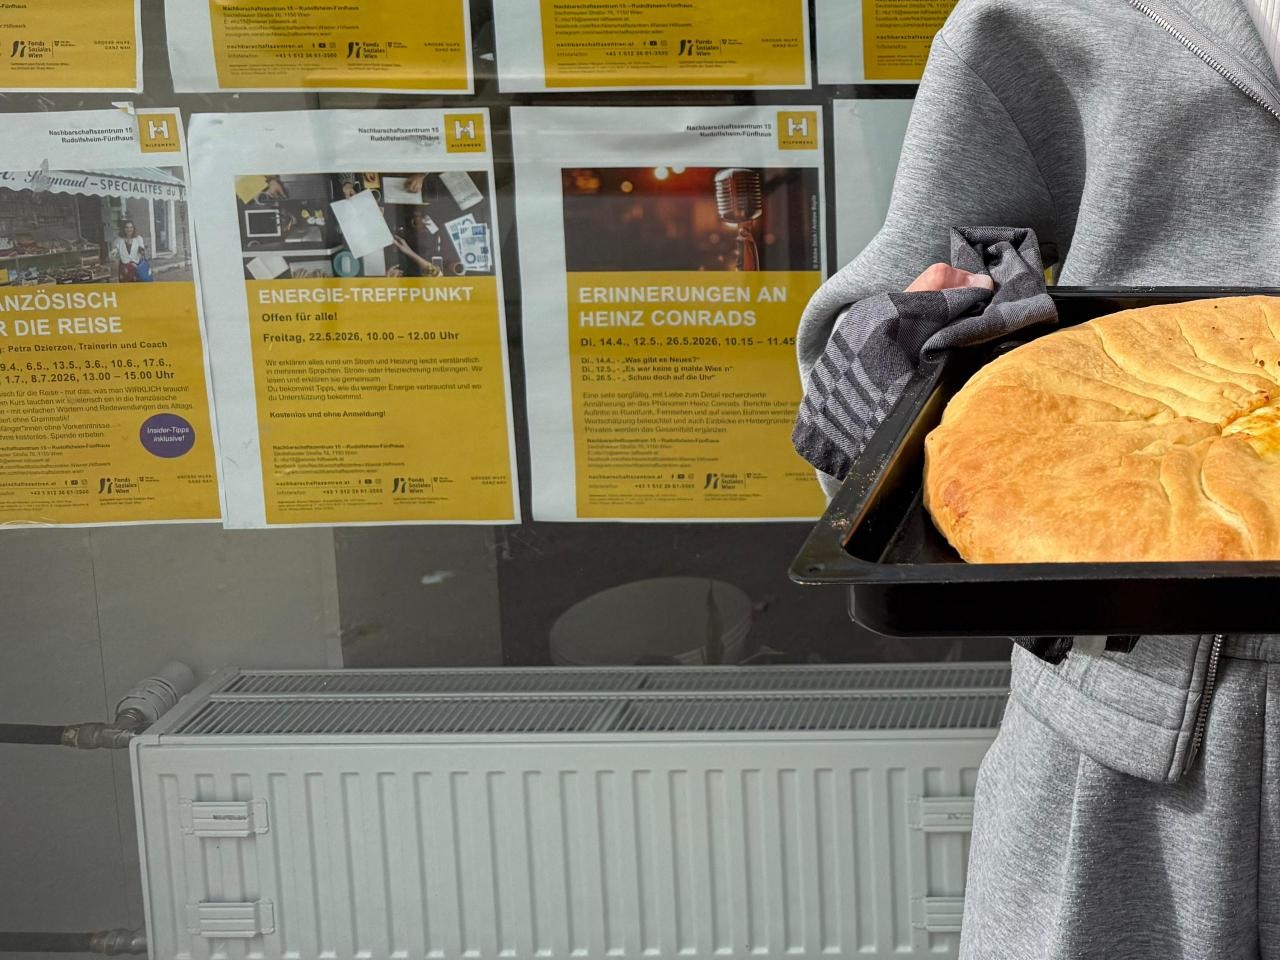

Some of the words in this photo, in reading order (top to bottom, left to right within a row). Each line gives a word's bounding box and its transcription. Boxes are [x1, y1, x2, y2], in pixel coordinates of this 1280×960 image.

[49, 128, 123, 137] Nachbarschaftszentrum
[259, 286, 473, 303] ENERGIE-TREFFPUNKT
[579, 286, 750, 302] ERINNERUNGEN
[757, 286, 786, 301] AN
[262, 313, 291, 321] Offen
[295, 312, 310, 320] für
[315, 312, 337, 320] alle!
[580, 310, 644, 326] HEINZ
[651, 310, 755, 326] CONRADS
[14, 319, 50, 336] DIE
[58, 316, 122, 334] REISE
[263, 333, 305, 343] Freitag,
[309, 332, 362, 341] 22.5.2026,
[367, 332, 394, 340] 10.00
[408, 331, 435, 340] 12.00
[439, 331, 458, 339] Uhr
[725, 337, 753, 345] 10.15
[79, 342, 117, 350] Trainerin
[139, 340, 167, 348] Coach
[26, 361, 48, 370] 6.5.,
[53, 360, 81, 370] 13.5.,
[85, 359, 107, 369] 3.6.,
[111, 358, 139, 368] 10.6.,
[143, 357, 171, 367] 17.6.,
[5, 375, 27, 384] 1.7.,
[31, 373, 79, 383] 8.7.2026,
[82, 372, 110, 380] 13.00
[124, 370, 151, 379] 15.00
[155, 370, 174, 378] Uhr
[147, 426, 190, 435] Insider-Tipps
[154, 434, 184, 442] inklusive!
